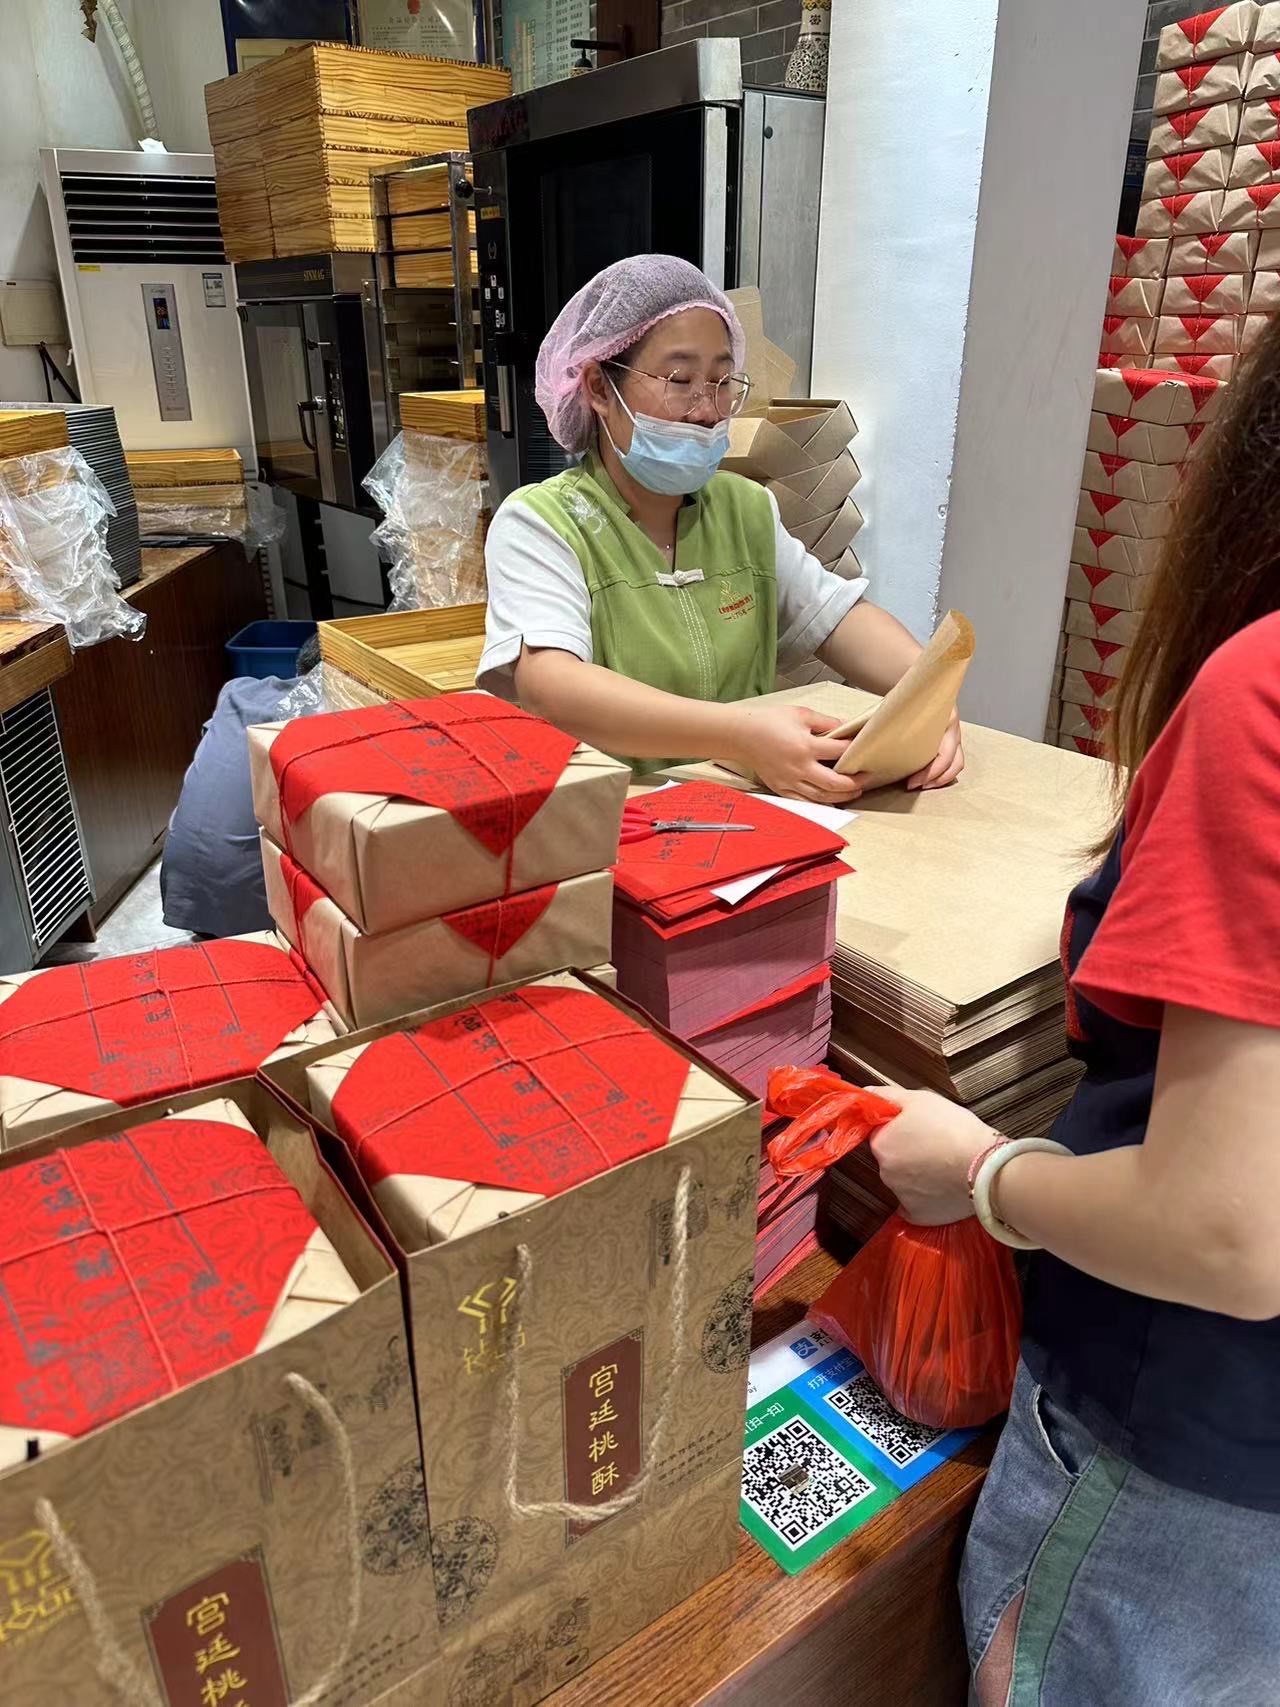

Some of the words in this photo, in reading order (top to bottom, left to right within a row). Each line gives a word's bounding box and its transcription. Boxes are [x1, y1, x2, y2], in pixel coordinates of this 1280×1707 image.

[589, 1363, 620, 1496] 宫廷桃酥
[186, 1591, 250, 1707] 宫廷桃
